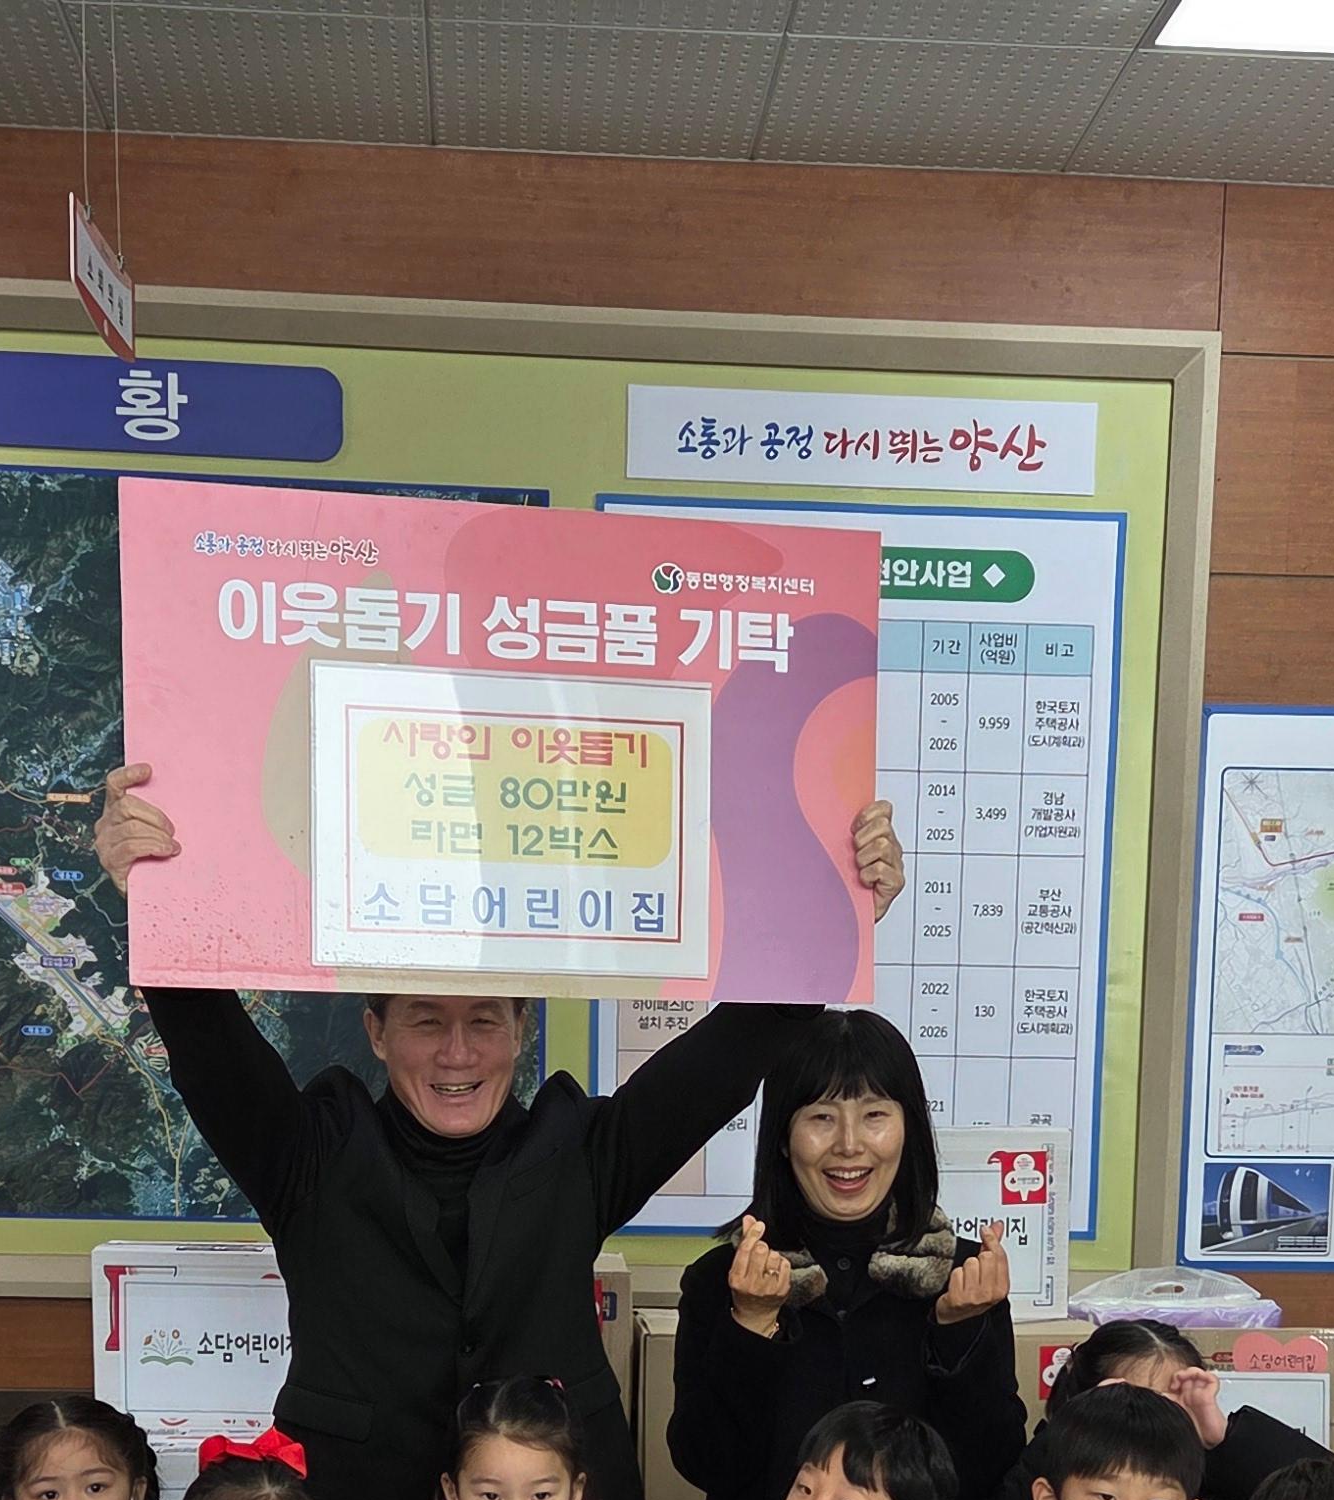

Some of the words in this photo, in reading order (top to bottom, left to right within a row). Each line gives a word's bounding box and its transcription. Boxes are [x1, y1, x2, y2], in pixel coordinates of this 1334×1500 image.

[677, 416, 754, 460] 소통과
[760, 421, 815, 460] 공정
[823, 427, 880, 461] 다시
[887, 428, 944, 464] 뛰는
[948, 418, 1048, 472] 양산
[194, 530, 232, 555] 소통과
[236, 535, 263, 557] 공정
[266, 538, 297, 558] 다시
[300, 539, 328, 561] 뛰는
[329, 536, 379, 567] 양산
[685, 571, 816, 597] 동면행정복지센터
[216, 578, 462, 656] 이웃돕기
[481, 595, 658, 667] 성금품
[677, 609, 794, 674] 기탁
[978, 632, 1018, 649] 사업비
[932, 638, 961, 656] 기간
[979, 648, 1017, 666] (억원)
[1045, 642, 1075, 658] 비고
[930, 692, 960, 707] 2005
[1035, 700, 1081, 715] 한국토지
[1034, 717, 1080, 732] 주택공사
[382, 720, 492, 762] 사랑의
[511, 726, 648, 769] 이웃돕기
[929, 737, 958, 752] 2026
[1027, 734, 1086, 749] (도시계획과)
[403, 772, 476, 808] 성금
[499, 776, 627, 815] 80만원
[927, 783, 956, 798] 2014
[1042, 791, 1066, 806] 경남
[975, 806, 1008, 821] 3,499
[1031, 807, 1077, 822] 개발공사
[410, 819, 484, 856] 라면
[505, 823, 620, 861] 12박스
[926, 828, 955, 842] 2025
[1024, 823, 1082, 839] (기업지원과)
[924, 881, 953, 895] 2011
[1038, 888, 1062, 903] 부산
[363, 881, 667, 934] 소담어린이집
[972, 904, 1004, 919] 7,839
[1027, 904, 1073, 919] 교통공사
[923, 924, 952, 938] 2025
[921, 982, 950, 996] 2022
[1024, 989, 1069, 1003] 한국토지
[974, 1005, 996, 1019] 130
[1023, 1006, 1068, 1020] 주택공사
[637, 1015, 662, 1030] 설치
[664, 1015, 689, 1031] 추진
[919, 1025, 948, 1039] 2026
